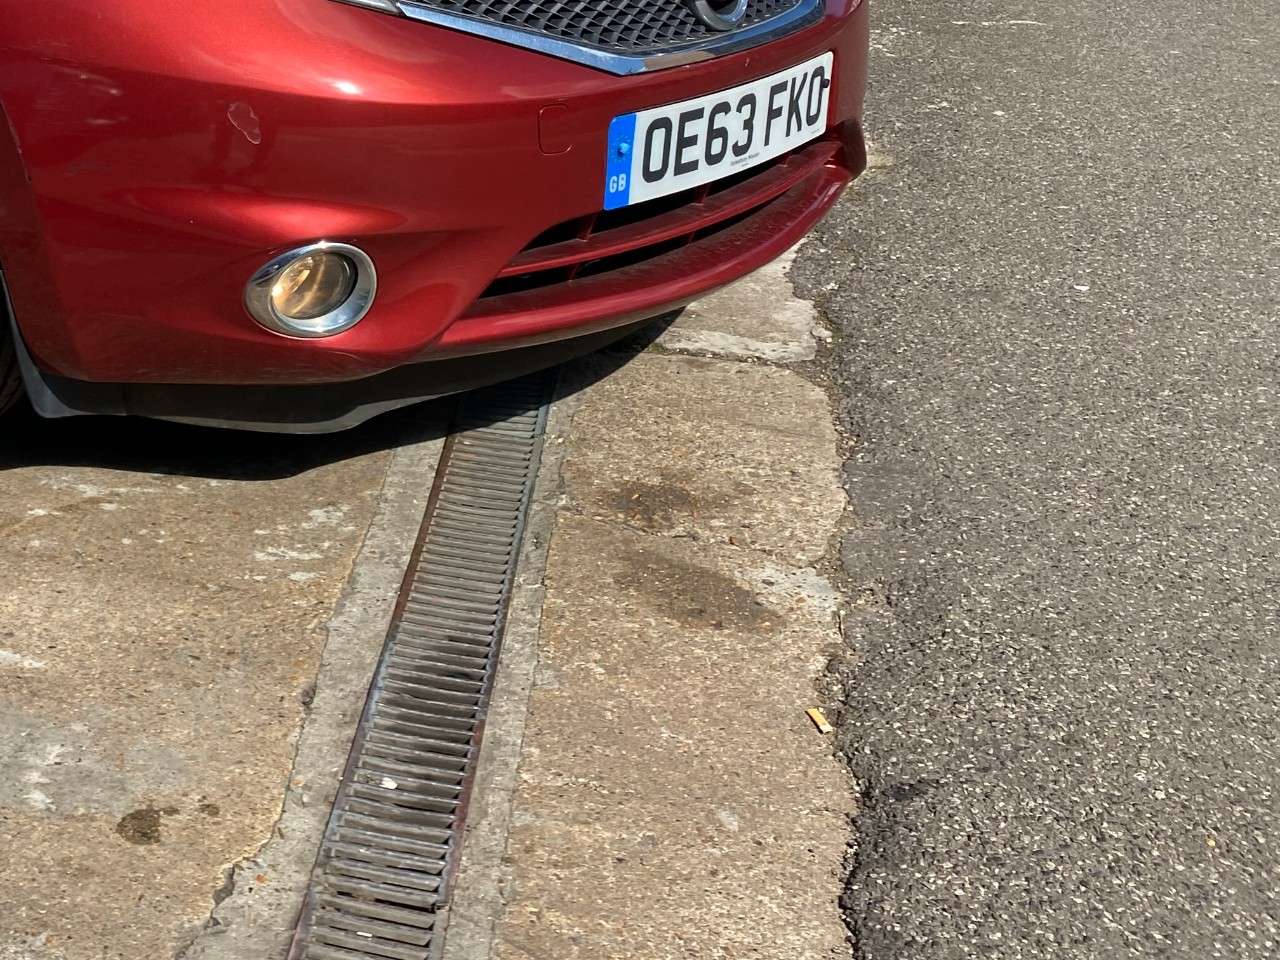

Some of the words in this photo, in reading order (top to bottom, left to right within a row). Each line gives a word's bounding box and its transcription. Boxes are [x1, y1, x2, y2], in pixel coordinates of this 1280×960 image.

[642, 92, 758, 184] OE63
[763, 65, 826, 148] FKO
[609, 172, 627, 194] GB
